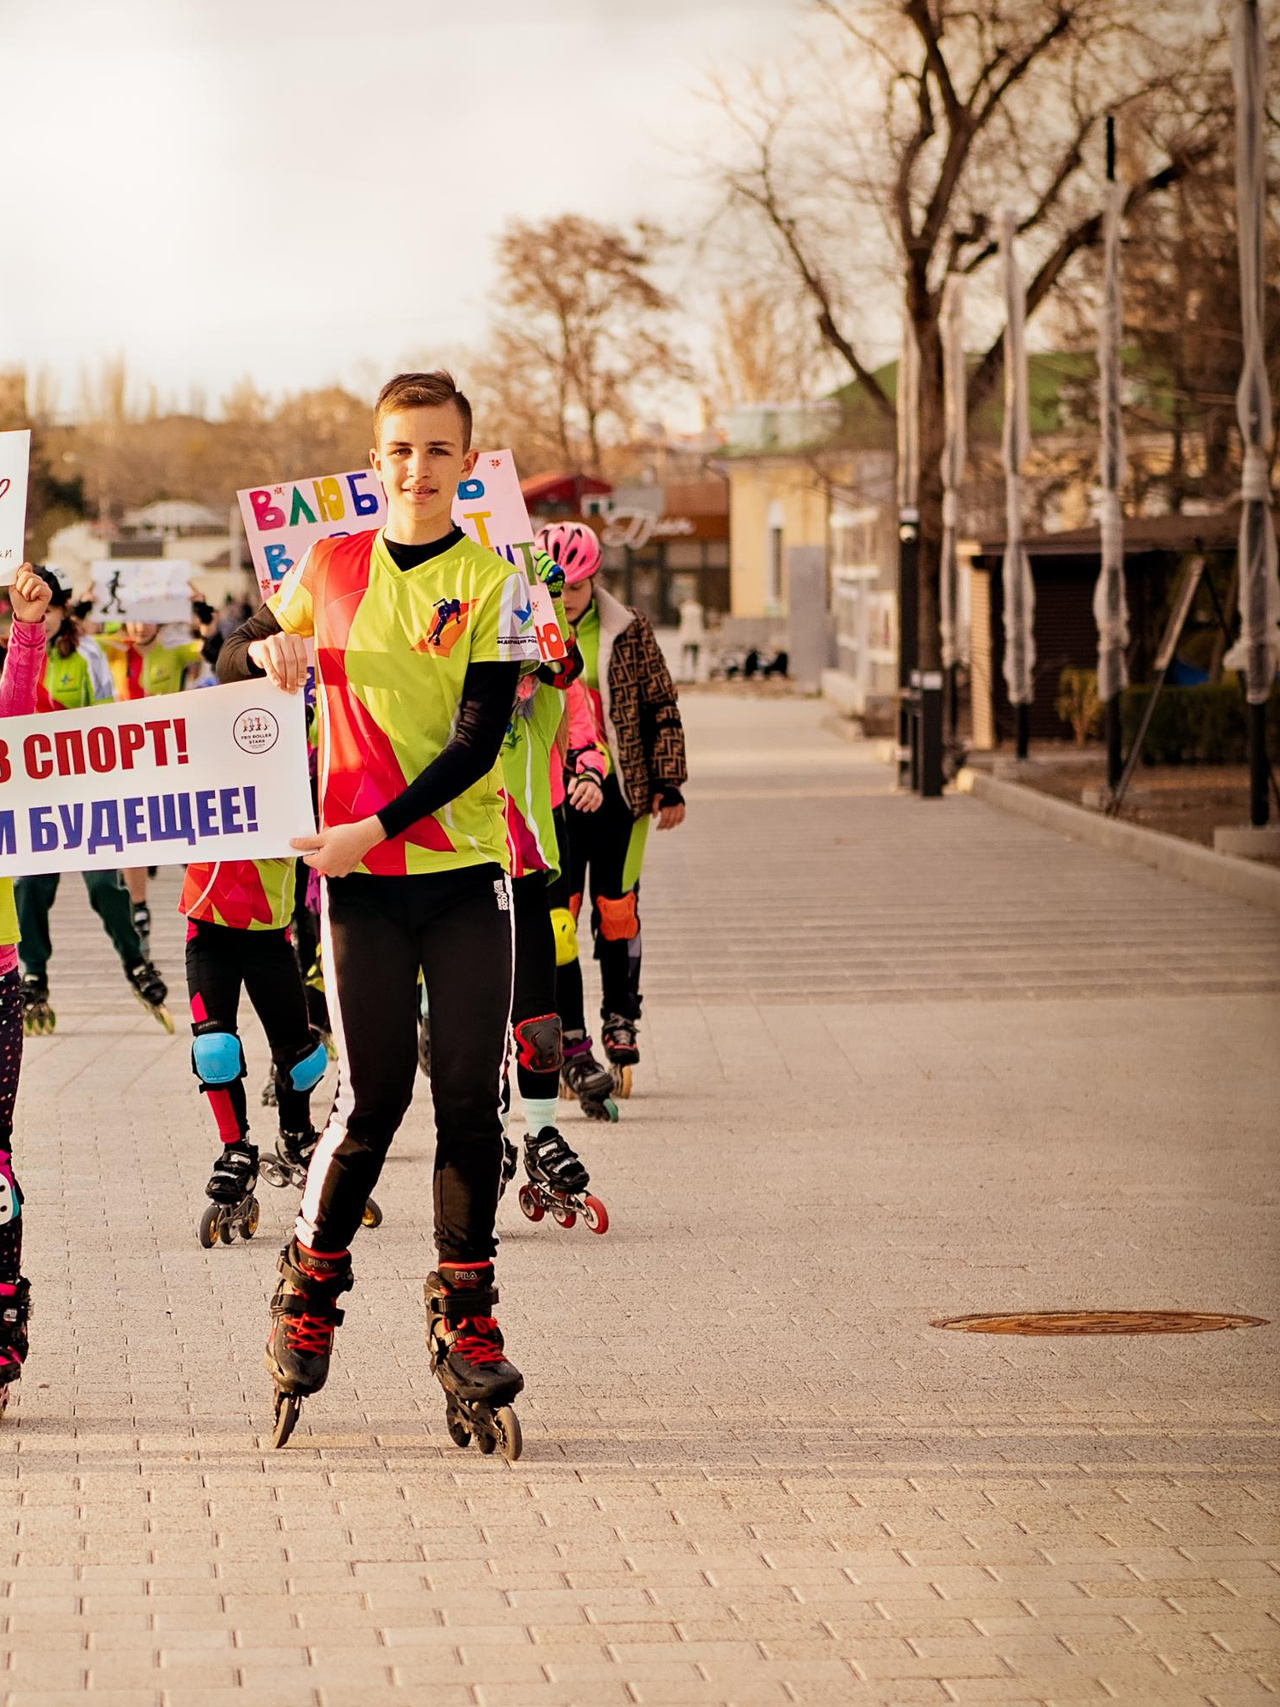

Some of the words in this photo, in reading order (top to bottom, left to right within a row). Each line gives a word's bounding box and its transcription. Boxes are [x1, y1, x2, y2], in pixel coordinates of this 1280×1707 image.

[23, 718, 189, 780] СПОРТ!
[28, 786, 259, 853] БУДЕЩЕЕ!
[307, 1257, 330, 1269] FILA
[454, 1271, 478, 1281] FILA
